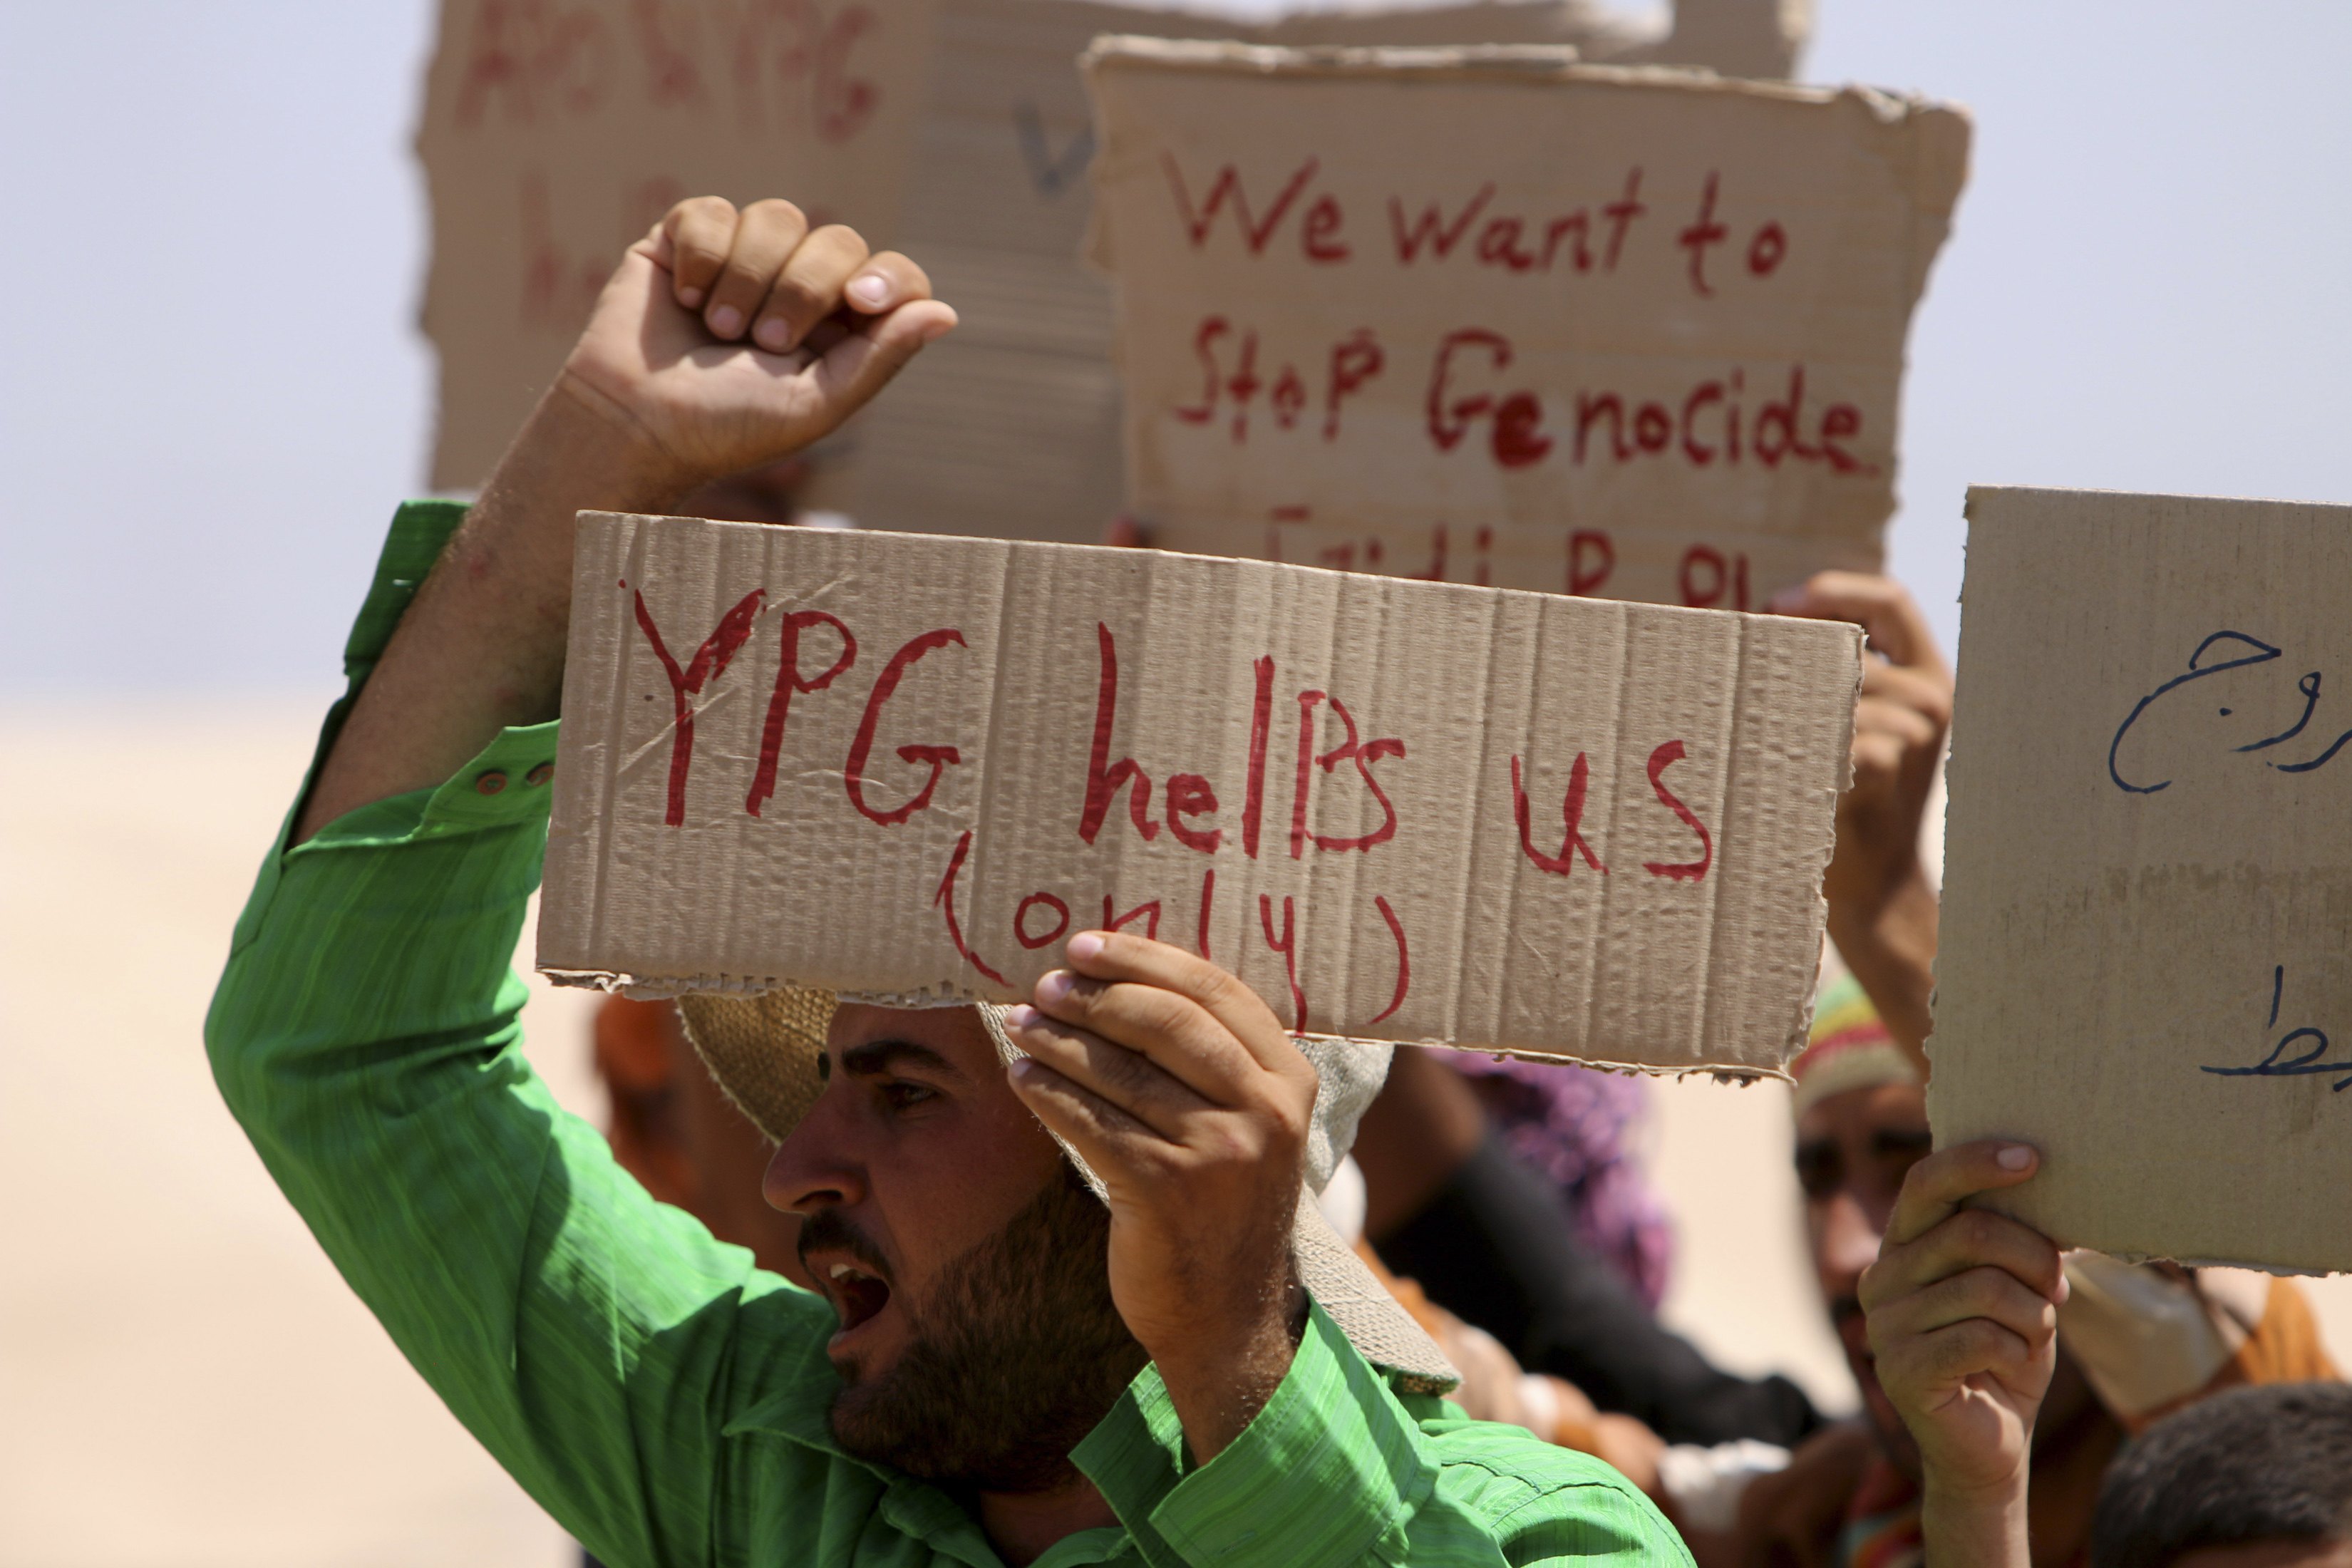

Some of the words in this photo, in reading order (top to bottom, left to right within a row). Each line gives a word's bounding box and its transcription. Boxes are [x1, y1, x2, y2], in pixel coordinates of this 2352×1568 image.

[1160, 151, 1352, 265] We
[1388, 168, 1648, 275] want
[1676, 171, 1789, 296] to
[636, 587, 968, 827] YPG
[1511, 739, 1713, 882] us
